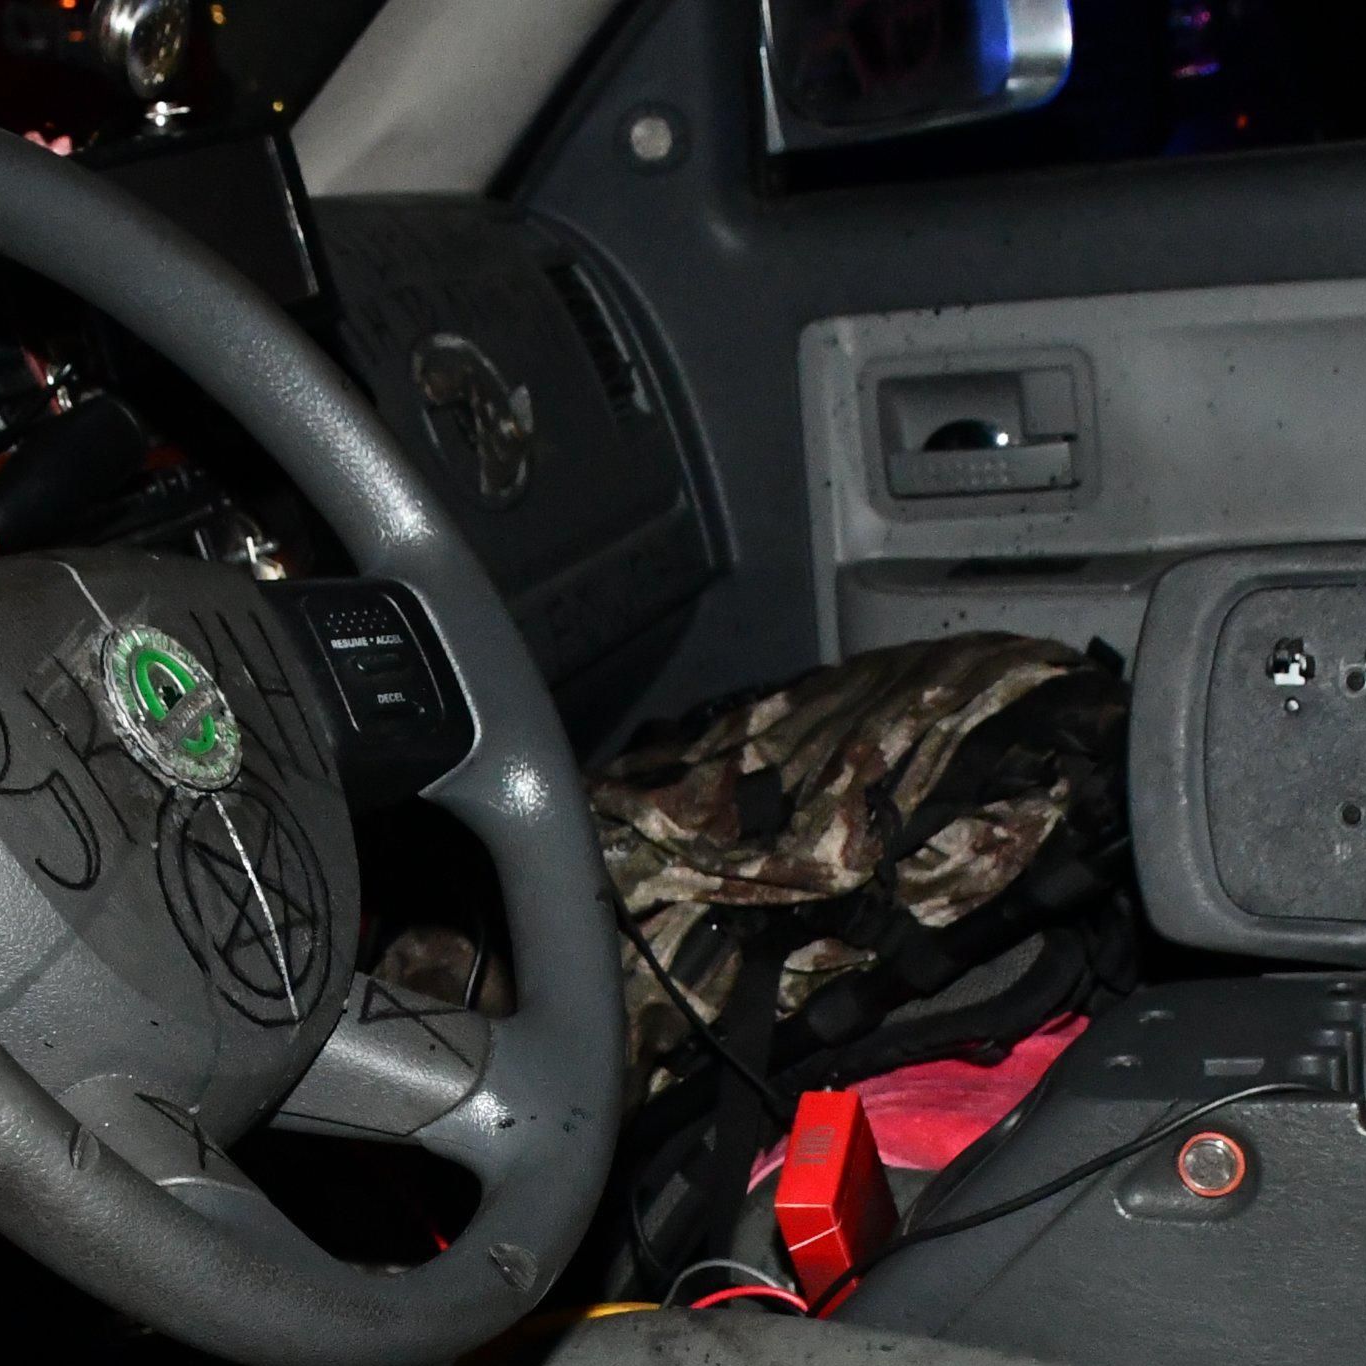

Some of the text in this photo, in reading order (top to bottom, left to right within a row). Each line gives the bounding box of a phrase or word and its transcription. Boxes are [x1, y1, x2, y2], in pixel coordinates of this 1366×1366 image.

[330, 634, 404, 649] RESUME ACCEL
[377, 692, 406, 704] DECEL
